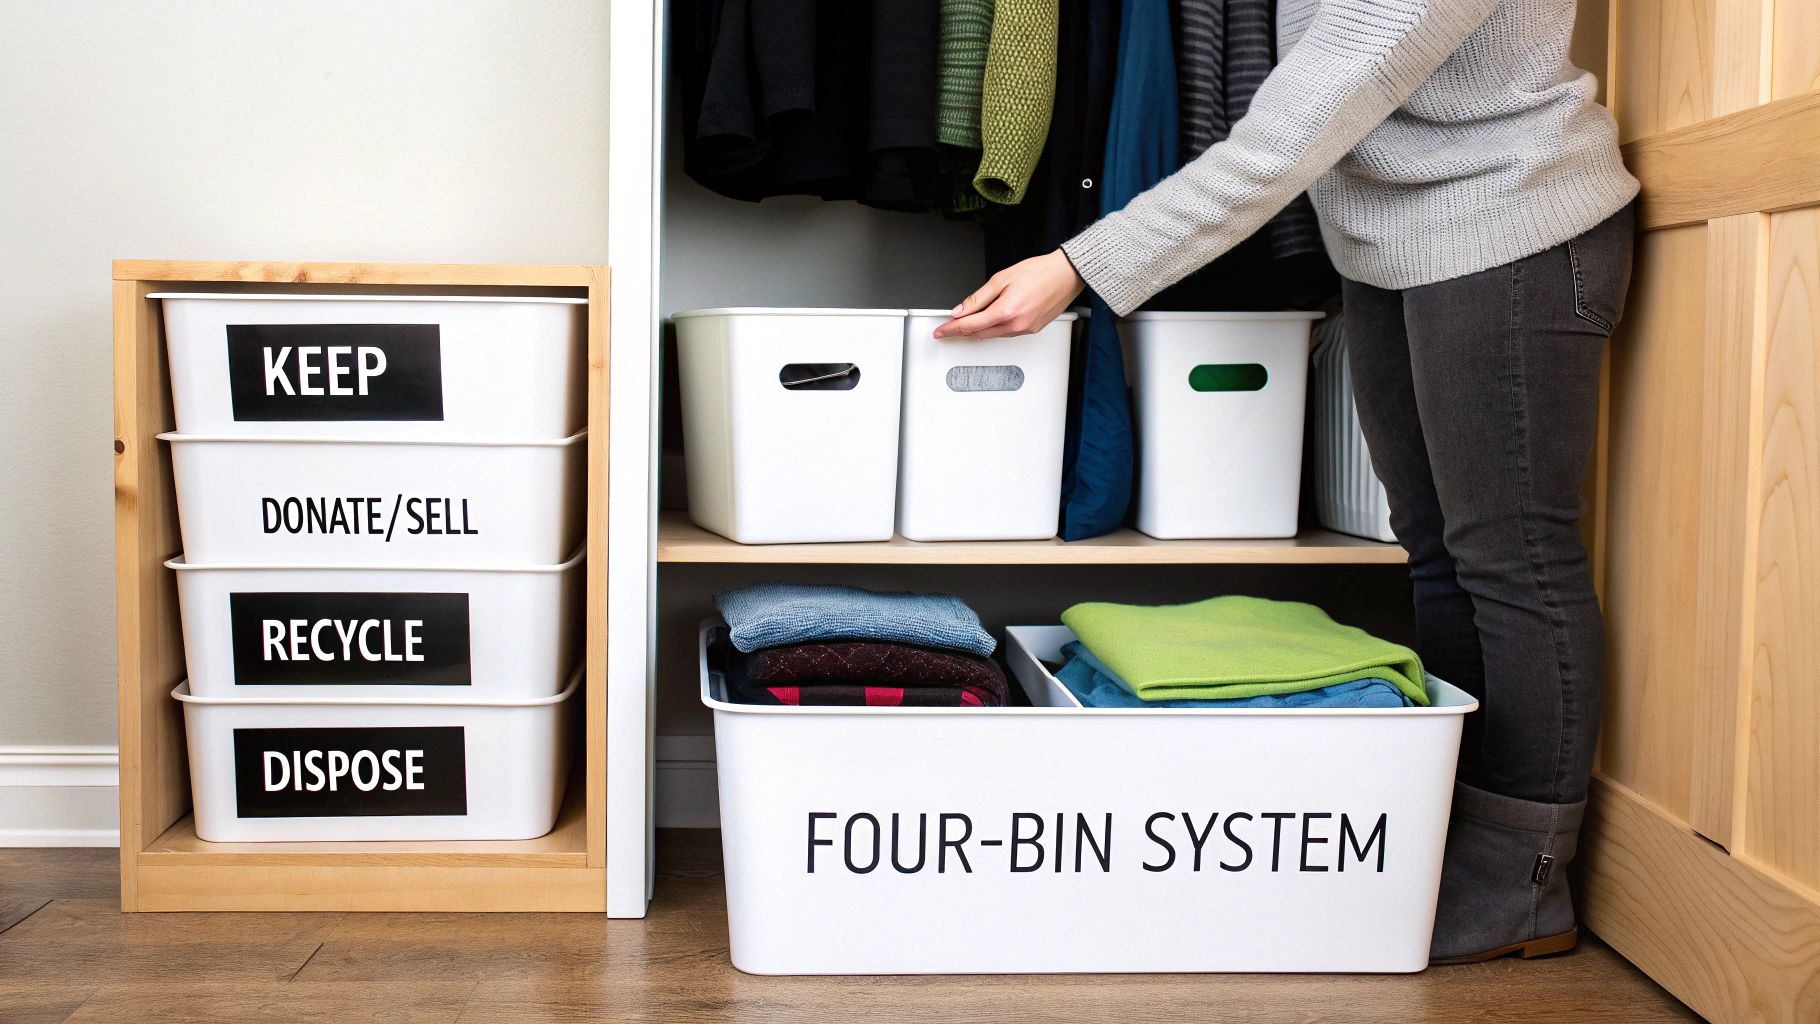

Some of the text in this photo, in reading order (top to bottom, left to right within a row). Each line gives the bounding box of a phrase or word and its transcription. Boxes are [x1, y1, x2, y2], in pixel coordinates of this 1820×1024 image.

[263, 345, 387, 396] KEEP
[261, 493, 479, 543] DONATE/SELL
[262, 618, 425, 663] RECYCLE
[263, 749, 425, 792] DISPOSE
[806, 811, 1388, 874] FOUR-BIN SYSTEM
